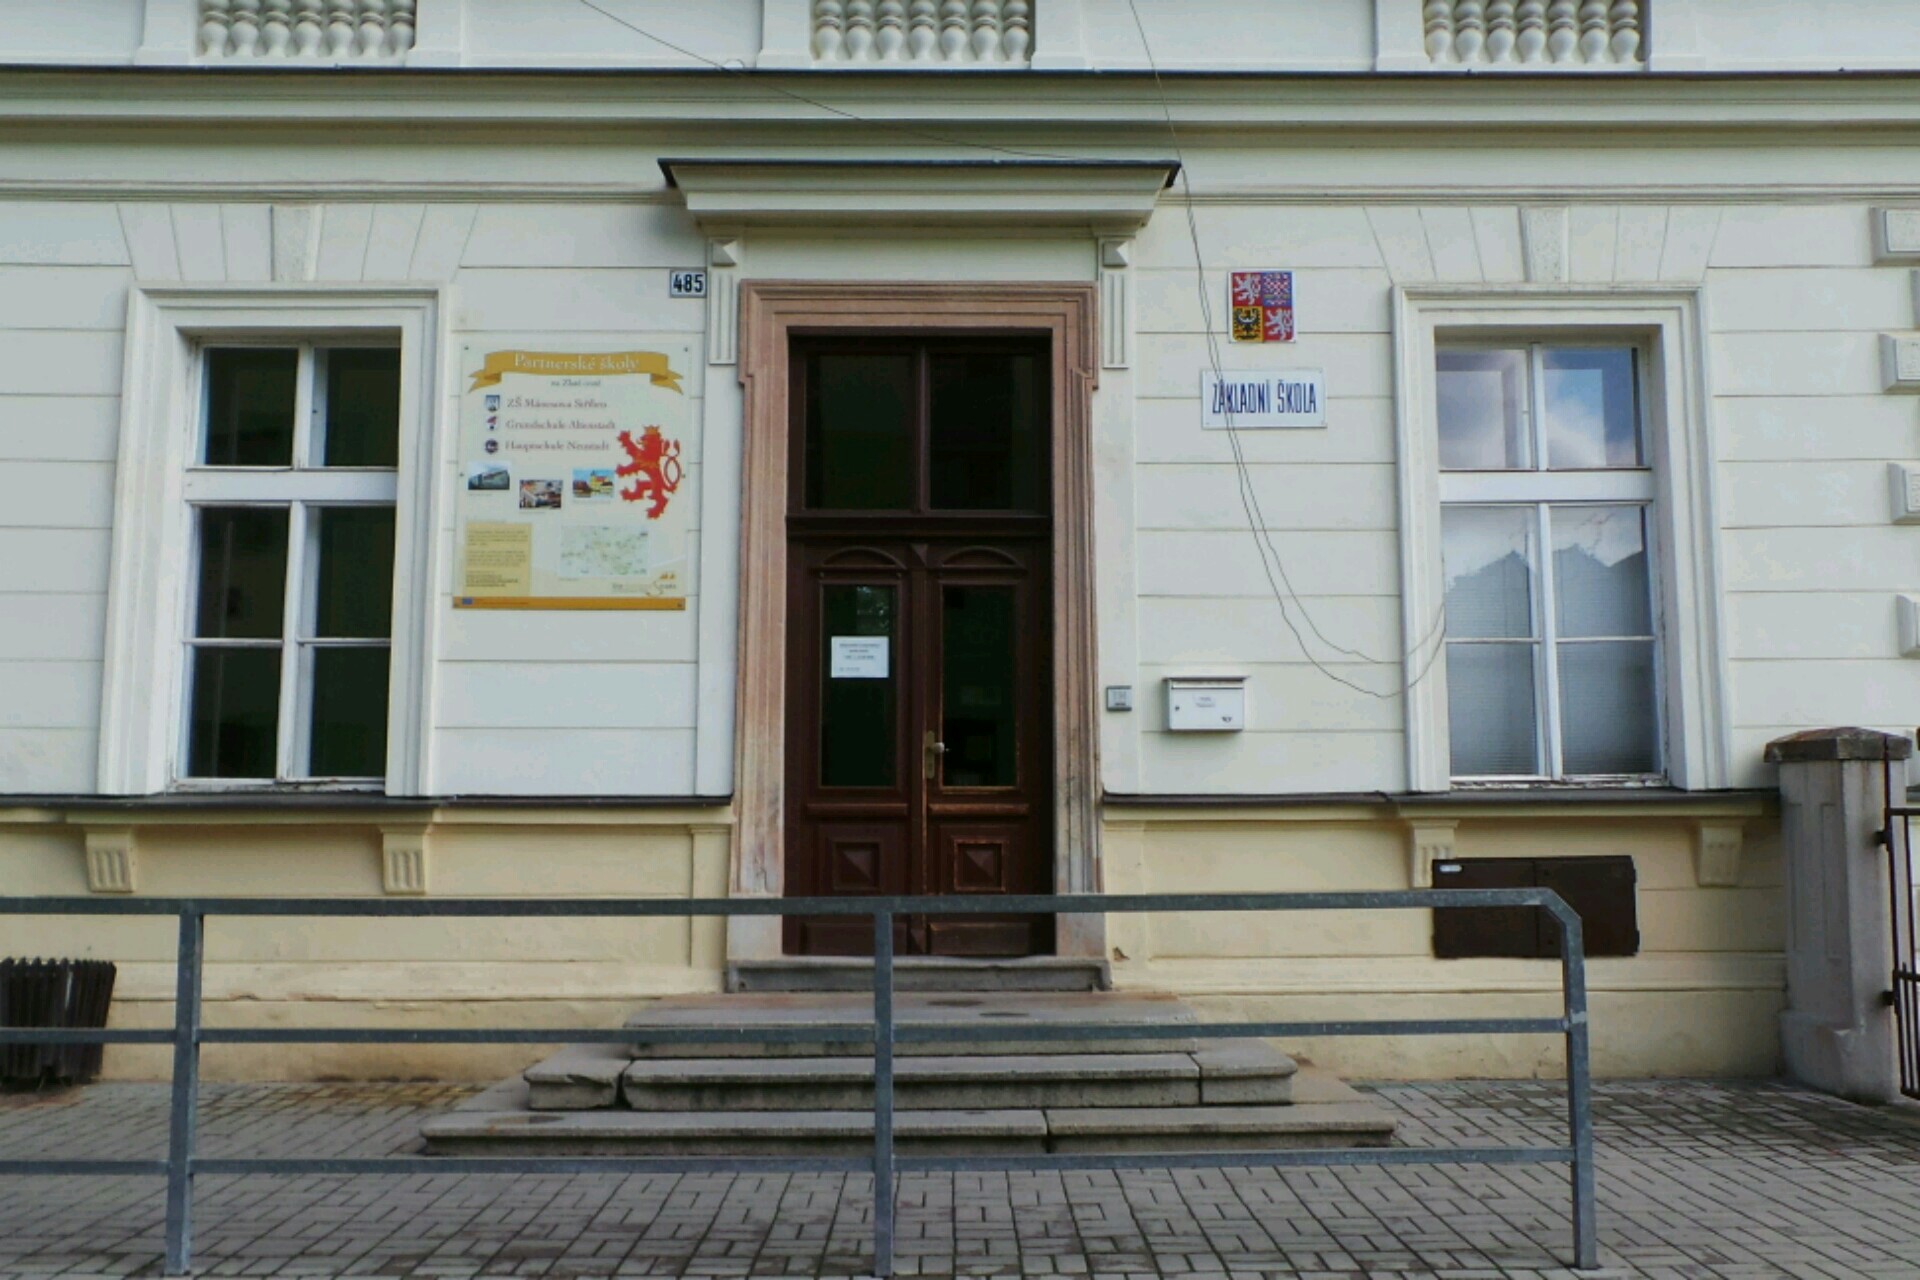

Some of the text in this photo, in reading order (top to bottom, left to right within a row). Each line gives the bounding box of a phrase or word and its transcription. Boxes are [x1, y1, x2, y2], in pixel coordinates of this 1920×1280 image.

[673, 273, 704, 293] 485
[515, 352, 640, 372] Partnerské školy
[506, 396, 522, 408] ZŠ
[1212, 379, 1317, 414] ZÁKLADNÍ ŠKOLA
